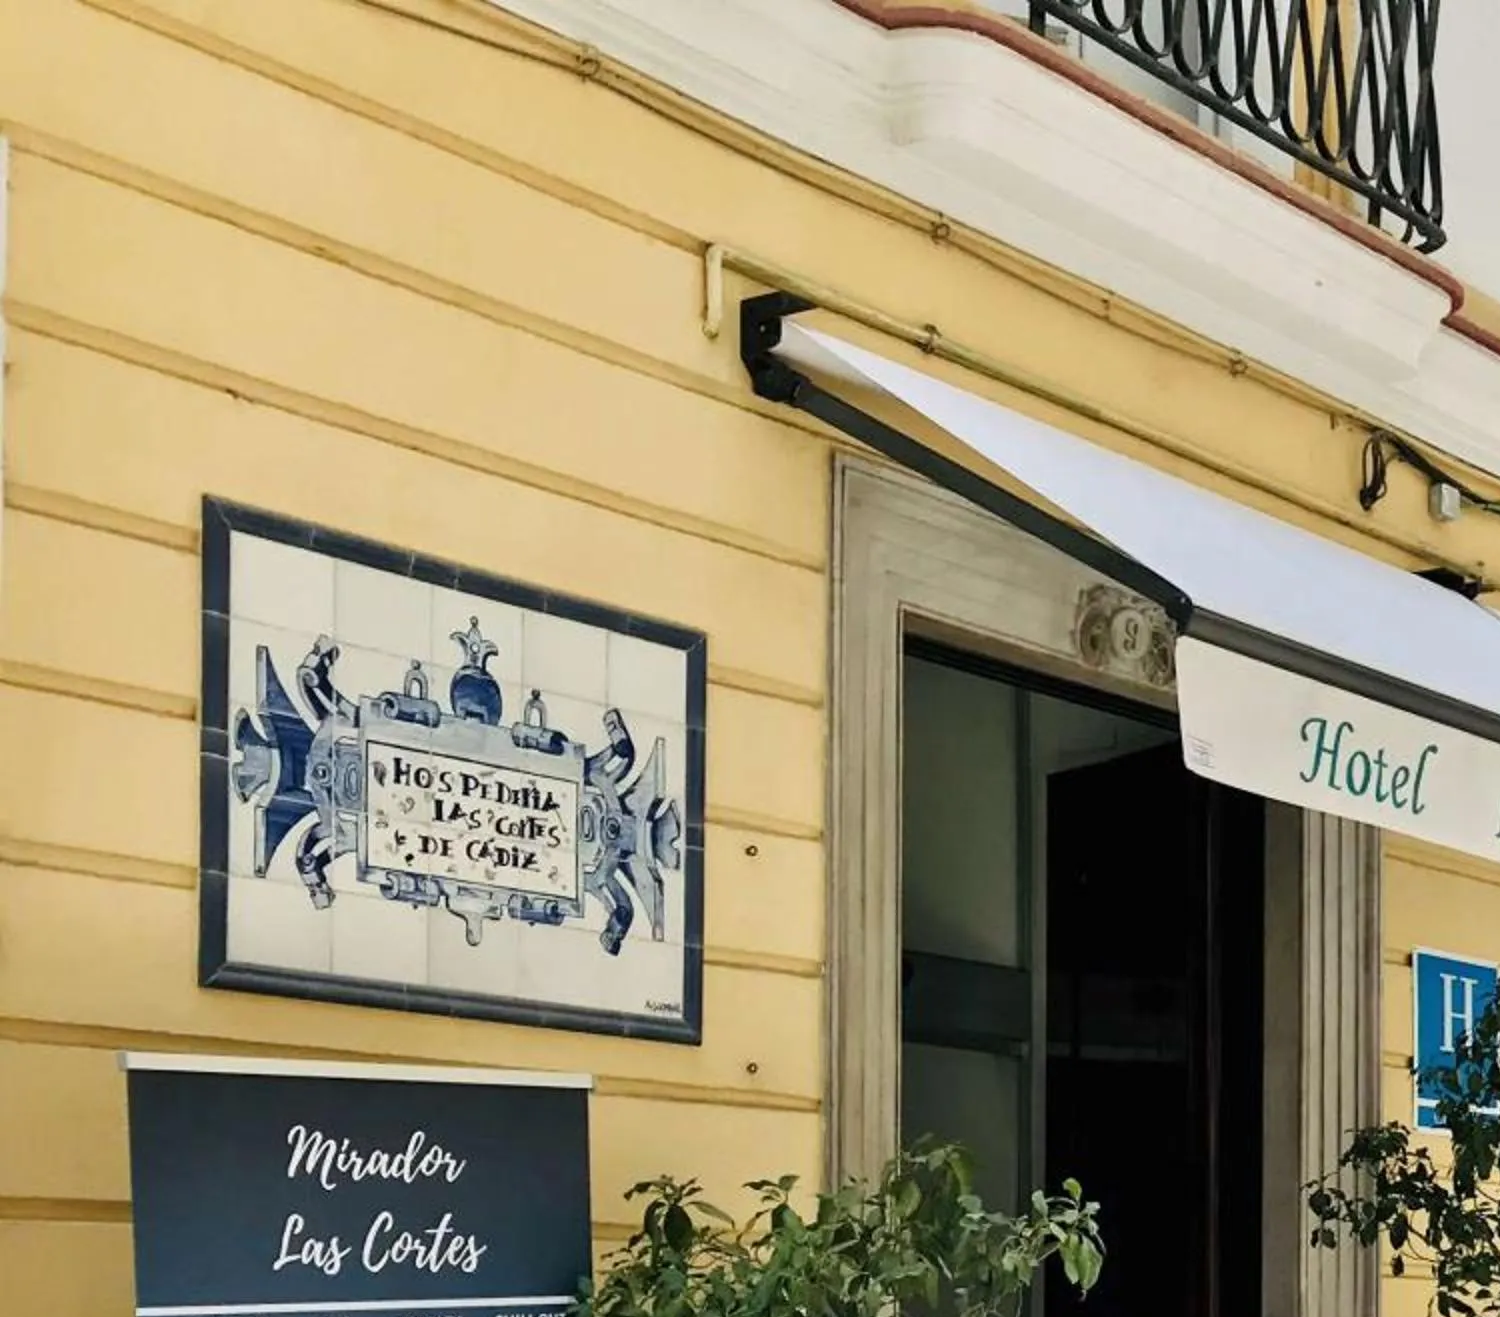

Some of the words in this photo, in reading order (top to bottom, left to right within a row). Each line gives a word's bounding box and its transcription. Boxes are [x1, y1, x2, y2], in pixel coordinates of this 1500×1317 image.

[1299, 717, 1438, 816] Hotel
[1439, 973, 1479, 1053] H
[286, 1124, 467, 1192] Mirador
[273, 1212, 352, 1276] Las
[361, 1211, 487, 1275] Cortes
